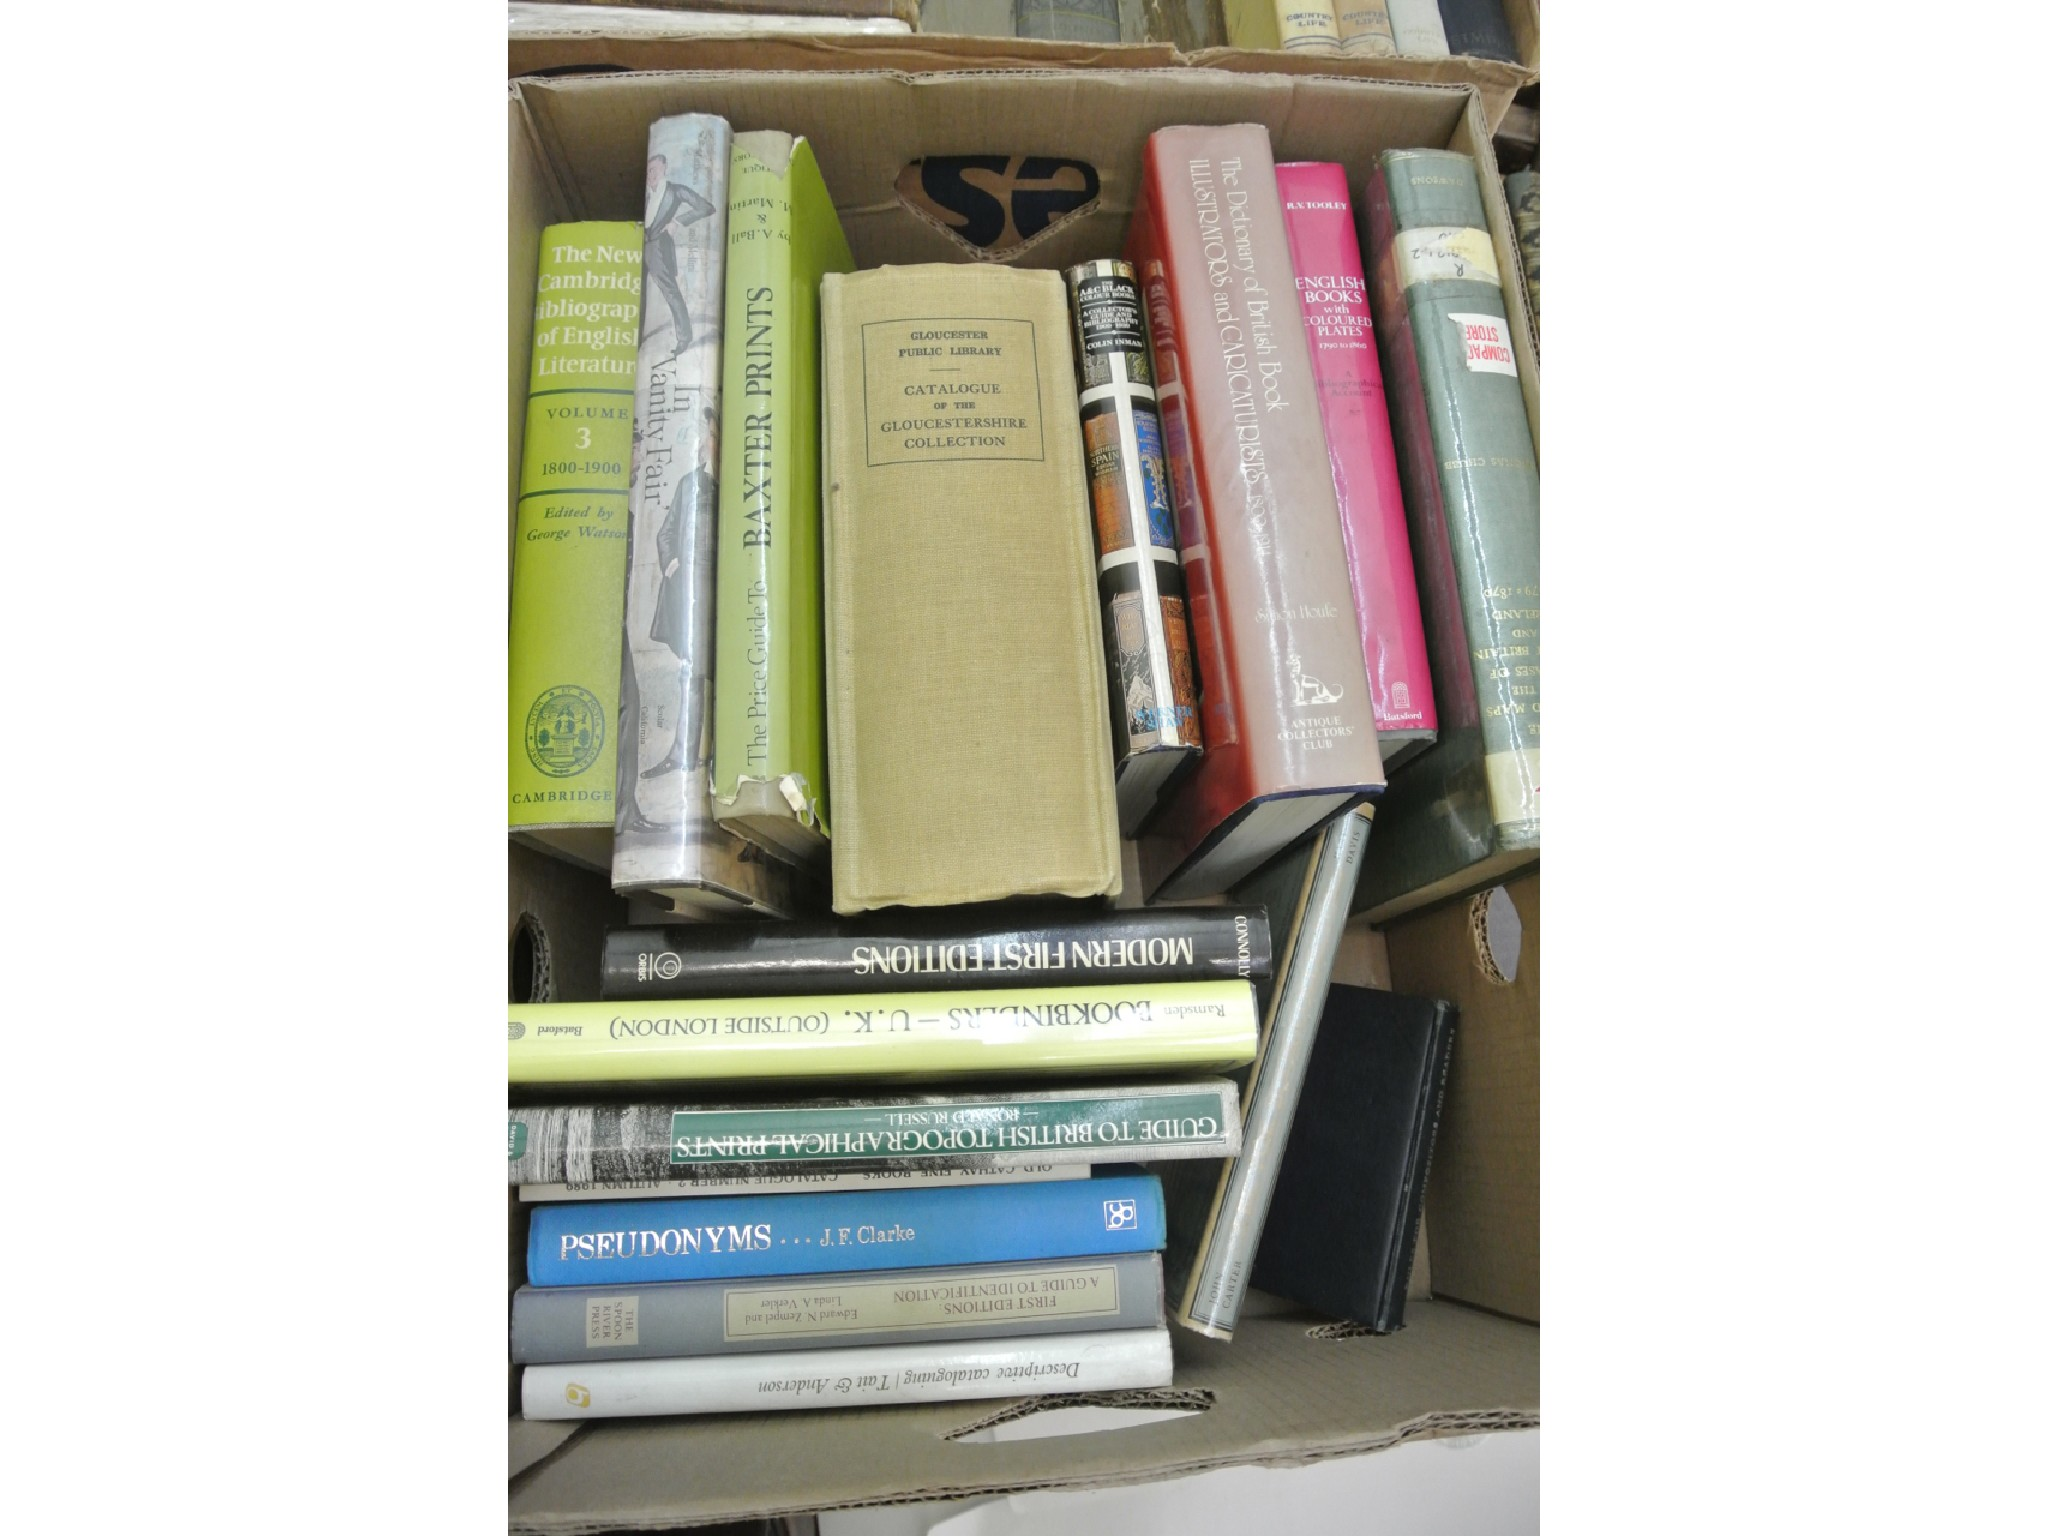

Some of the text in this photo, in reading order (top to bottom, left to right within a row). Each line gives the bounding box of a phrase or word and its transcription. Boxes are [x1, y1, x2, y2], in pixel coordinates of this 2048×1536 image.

[1286, 12, 1332, 22] COUNTRY
[1305, 201, 1348, 211] TOOLEY
[757, 214, 767, 224] &
[1189, 159, 1233, 288] ILLUSTRATORS
[1213, 292, 1240, 324] and
[551, 245, 642, 264] The New
[1454, 263, 1464, 278] R
[537, 270, 642, 296] Cambridg
[1102, 285, 1134, 295] BLACK
[1221, 156, 1290, 413] The Dictionary of British Book
[1294, 276, 1366, 291] ENGLISH
[1305, 290, 1363, 304] BOOKS
[533, 298, 639, 323] ibliograp
[1323, 304, 1350, 314] with
[1303, 315, 1373, 327] COLOURED
[536, 326, 560, 348] of
[910, 330, 989, 341] GLOUCESTER
[1317, 325, 1363, 337] PLATES
[1086, 338, 1143, 350] COLIN INMAN
[1319, 341, 1338, 350] 1790
[1339, 341, 1349, 350] to
[898, 347, 1002, 358] PUBLIC LIBRARY
[1467, 343, 1511, 363] COMPAC
[537, 355, 637, 377] Literatur
[904, 383, 1002, 396] CATALOGUE
[673, 384, 702, 413] In
[933, 401, 976, 410] OF THE
[545, 407, 630, 420] VOLUME
[742, 286, 774, 550] PRINTS BAXTER
[880, 417, 1027, 433] GLOUCESTERSHIRE
[575, 426, 592, 450] 3
[904, 436, 1006, 450] COLLECTION
[1090, 450, 1119, 468] SPAIN
[542, 461, 622, 476] 1800-1900
[543, 505, 615, 521] Edited by
[526, 528, 571, 542] George
[1256, 606, 1296, 624] Simon
[1511, 629, 1537, 638] AND
[1473, 646, 1529, 660] BRITAIN
[746, 579, 768, 767] To Guide Price The
[1511, 684, 1536, 696] THE
[1485, 702, 1526, 717] MAPS
[1290, 715, 1342, 729] ANTIQUE
[1302, 738, 1334, 750] CLUB
[511, 790, 613, 805] CAMBRIDGE
[1346, 831, 1361, 865] DAVIS
[1234, 915, 1251, 979] CONNOLLY
[852, 937, 1194, 975] MODERN FIRST EDITIONS
[948, 1000, 1153, 1030] BOOKBINDERS
[1163, 1003, 1226, 1018] Ramsden
[609, 1016, 718, 1040] LONDON)
[724, 1011, 830, 1034] (OUTSIDE
[537, 1025, 583, 1037] Batsford
[885, 1111, 950, 1127] RUSSELL
[676, 1116, 1218, 1158] GUIDE TO BRITISH TOPOGRAPHICAL PRINTS
[690, 1175, 750, 1187] NUMBER
[754, 1173, 838, 1184] CATALOGUE
[862, 1171, 912, 1180] BOOKS
[565, 1181, 598, 1191] 1989
[603, 1180, 661, 1189] AUTUMN
[857, 1223, 916, 1245] Clarke
[560, 1223, 772, 1261] PSEUDONYMS
[893, 1276, 1100, 1303] A GUIDE TO IDENTIFICATION
[1208, 1271, 1223, 1304] JOHN
[1222, 1261, 1242, 1309] CARTER
[760, 1297, 798, 1310] Verkler
[813, 1296, 842, 1307] Linda
[1019, 1295, 1057, 1309] FIRST
[602, 1305, 612, 1339] RIVER
[613, 1301, 624, 1341] SPOON
[624, 1310, 634, 1333] THE
[745, 1313, 765, 1325] and
[766, 1311, 805, 1325] Zempel
[818, 1308, 858, 1321] Edward
[590, 1305, 600, 1340] PRESS
[758, 1361, 1081, 1396] Descriptive cataloguing Tait & Anderson
